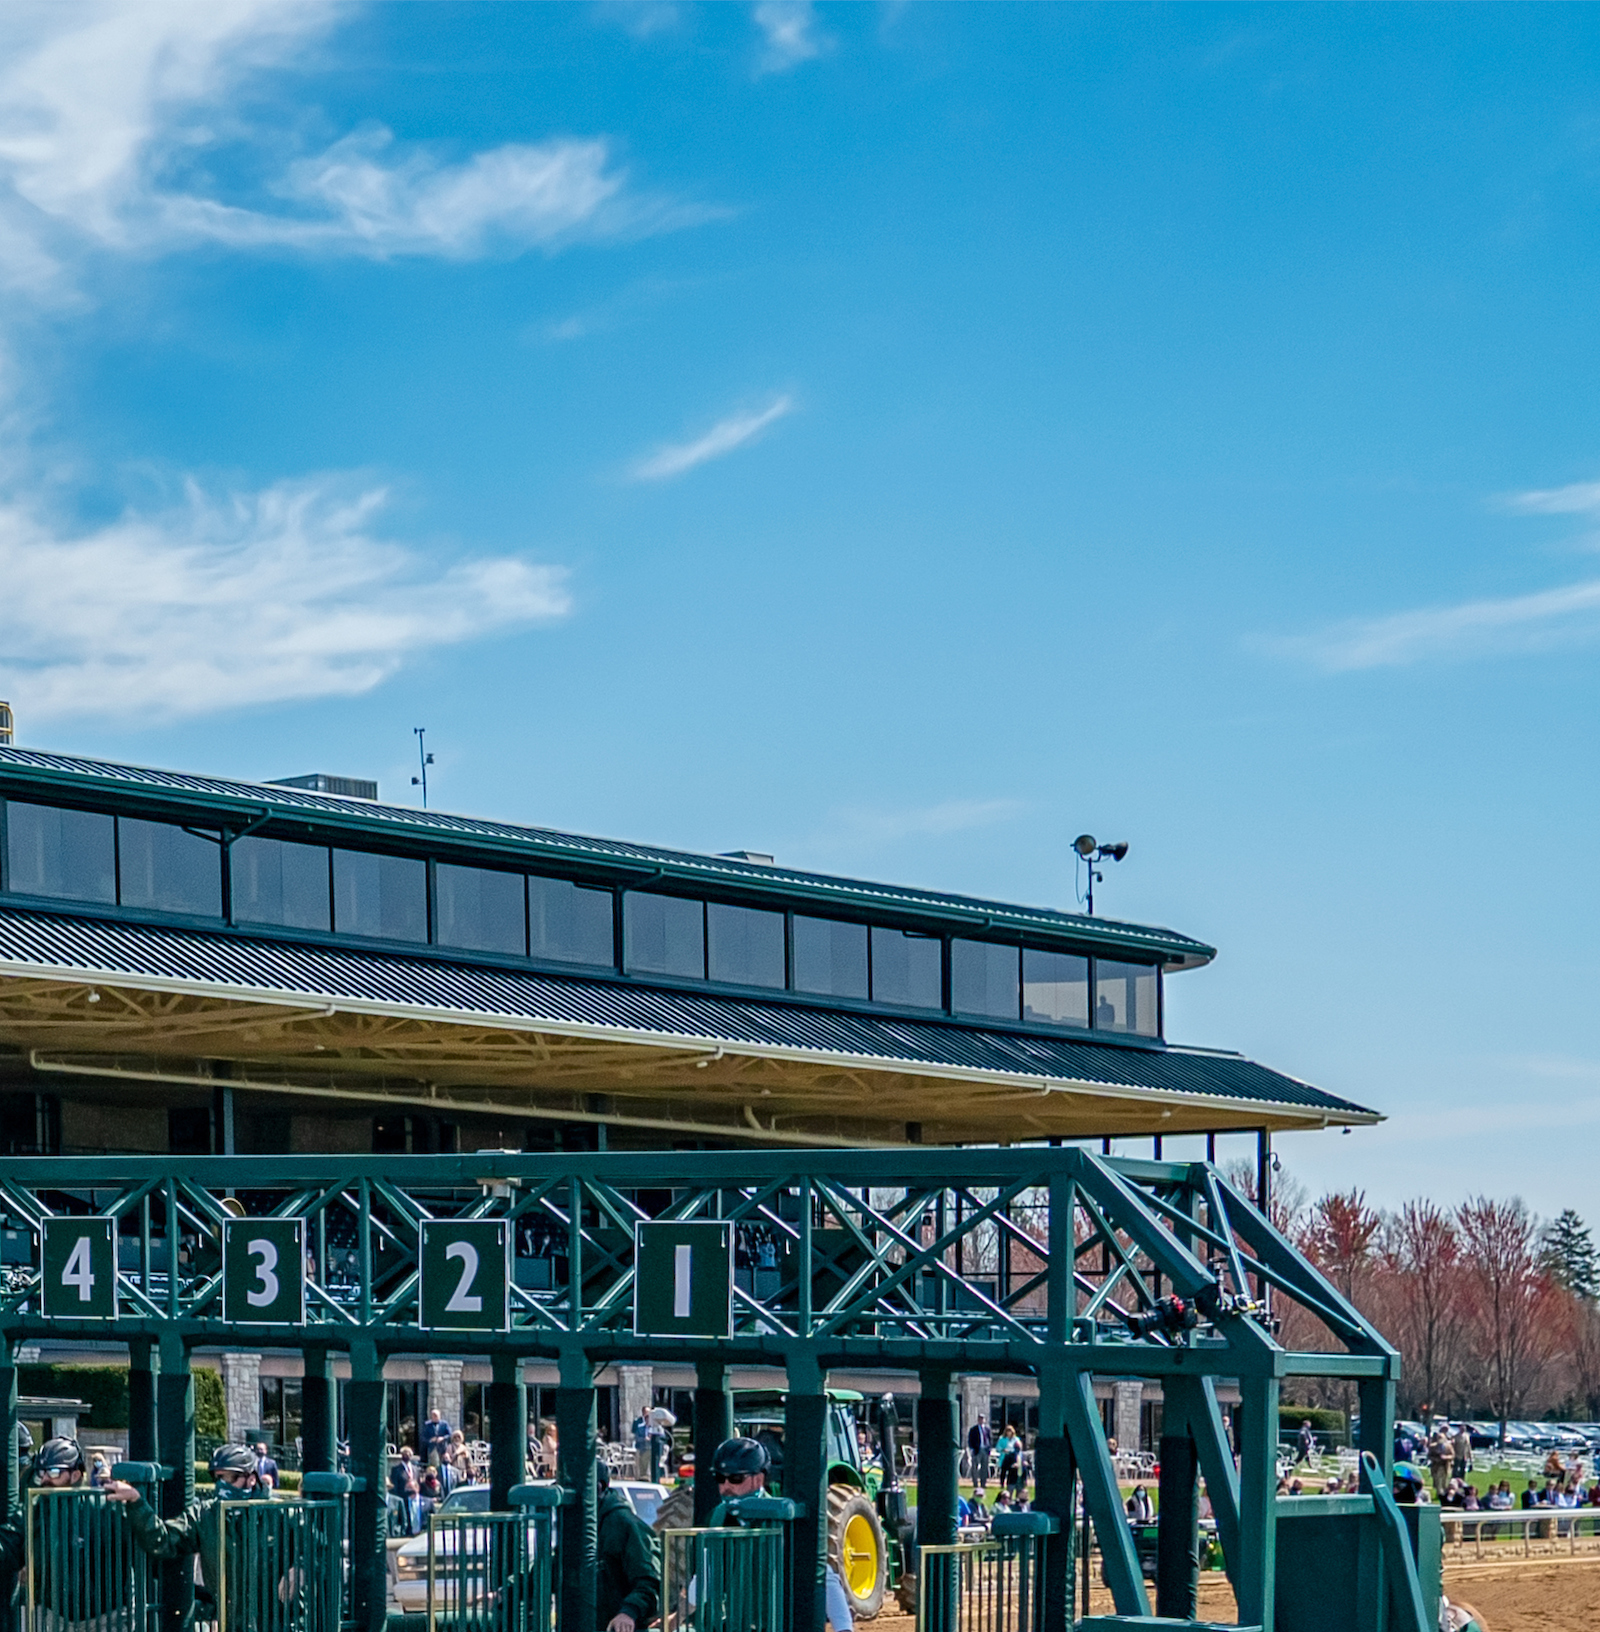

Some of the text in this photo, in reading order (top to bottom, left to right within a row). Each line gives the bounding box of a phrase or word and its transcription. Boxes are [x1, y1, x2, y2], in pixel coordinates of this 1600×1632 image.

[61, 1236, 95, 1301] 4
[247, 1239, 279, 1307] 3
[445, 1241, 482, 1312] 2
[674, 1244, 691, 1317] 1
